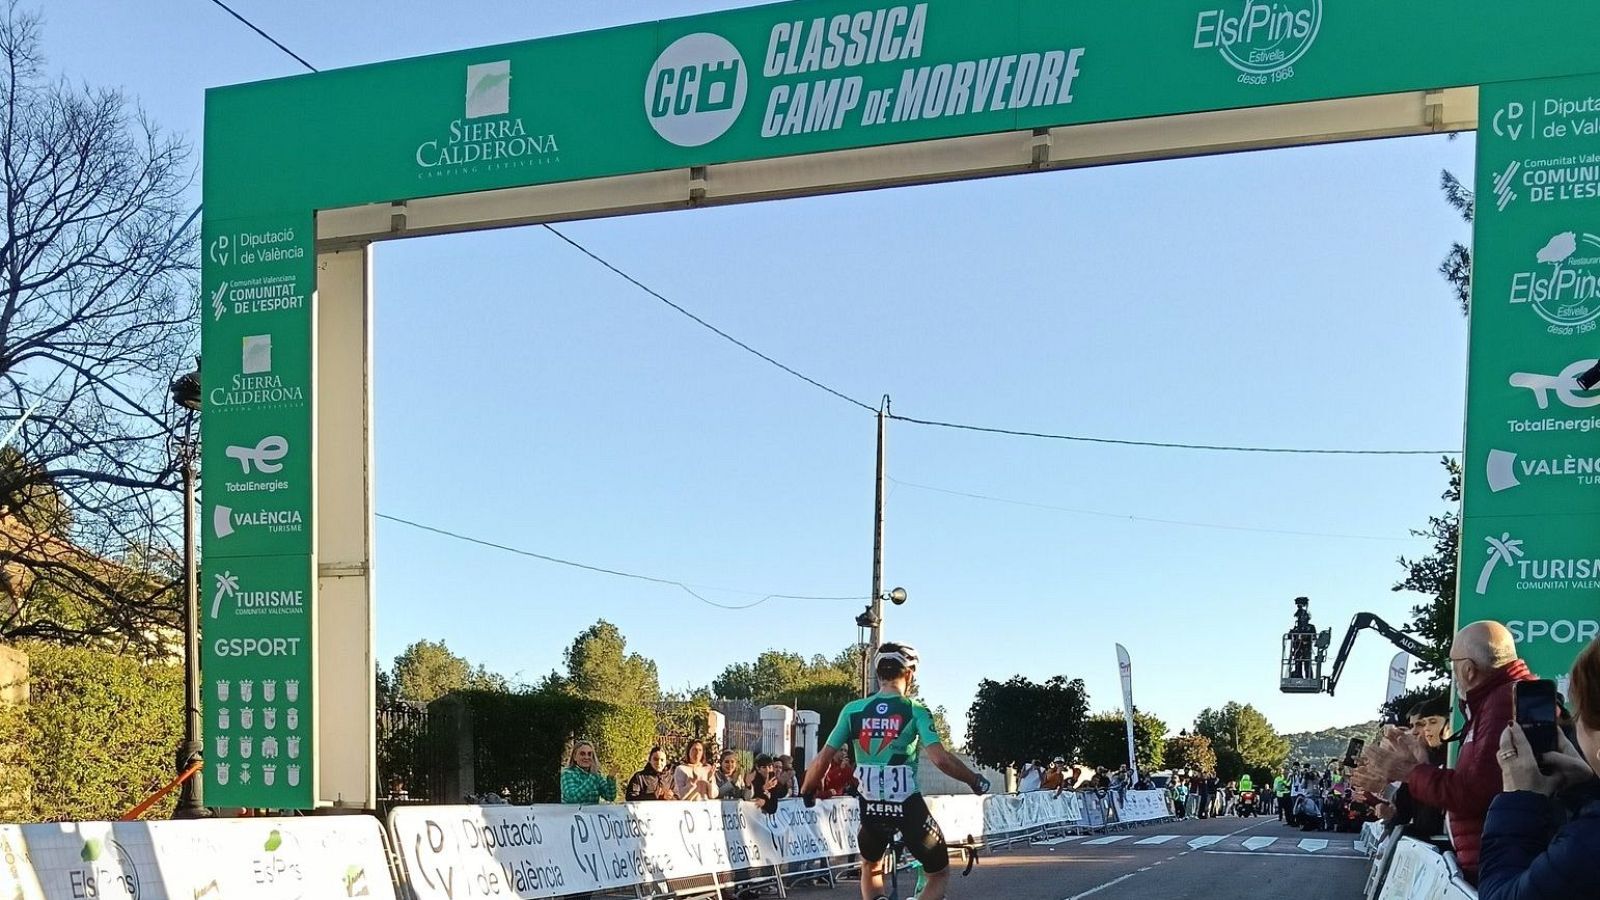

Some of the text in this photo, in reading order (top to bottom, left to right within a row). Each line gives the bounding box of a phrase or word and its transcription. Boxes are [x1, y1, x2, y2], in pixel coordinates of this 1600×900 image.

[763, 3, 928, 78] CLASSICA
[1249, 50, 1284, 62] Estivella
[1237, 66, 1294, 85] desde 1968
[760, 48, 1086, 138] CAMP DE MORVEDRE
[449, 118, 526, 145] SIERRA
[1543, 121, 1567, 138] de
[416, 134, 559, 167] CALDERONA
[1524, 155, 1576, 168] Comunitat
[1531, 186, 1554, 202] DE
[240, 228, 294, 248] Diputació
[240, 246, 304, 265] de València
[230, 283, 296, 301] COMUNITAT
[235, 296, 304, 314] DE L'ESPORT
[1547, 321, 1597, 335] desde 1968
[232, 374, 282, 391] SIERRA
[210, 387, 303, 406] CALDERONA
[225, 480, 288, 492] TotalEnergies
[234, 509, 302, 526] VALÈNCIA
[269, 524, 302, 533] TURISME
[1516, 581, 1568, 590] COMUNITAT
[235, 590, 303, 607] TURISME
[235, 607, 303, 616] COMUNITAT VALENCIANA
[215, 637, 301, 656] GSPORT
[862, 717, 900, 730] KERN
[892, 766, 907, 793] 31
[866, 803, 903, 813] KERN
[462, 815, 542, 857] Diputació
[612, 852, 628, 879] de
[477, 860, 565, 896] de València
